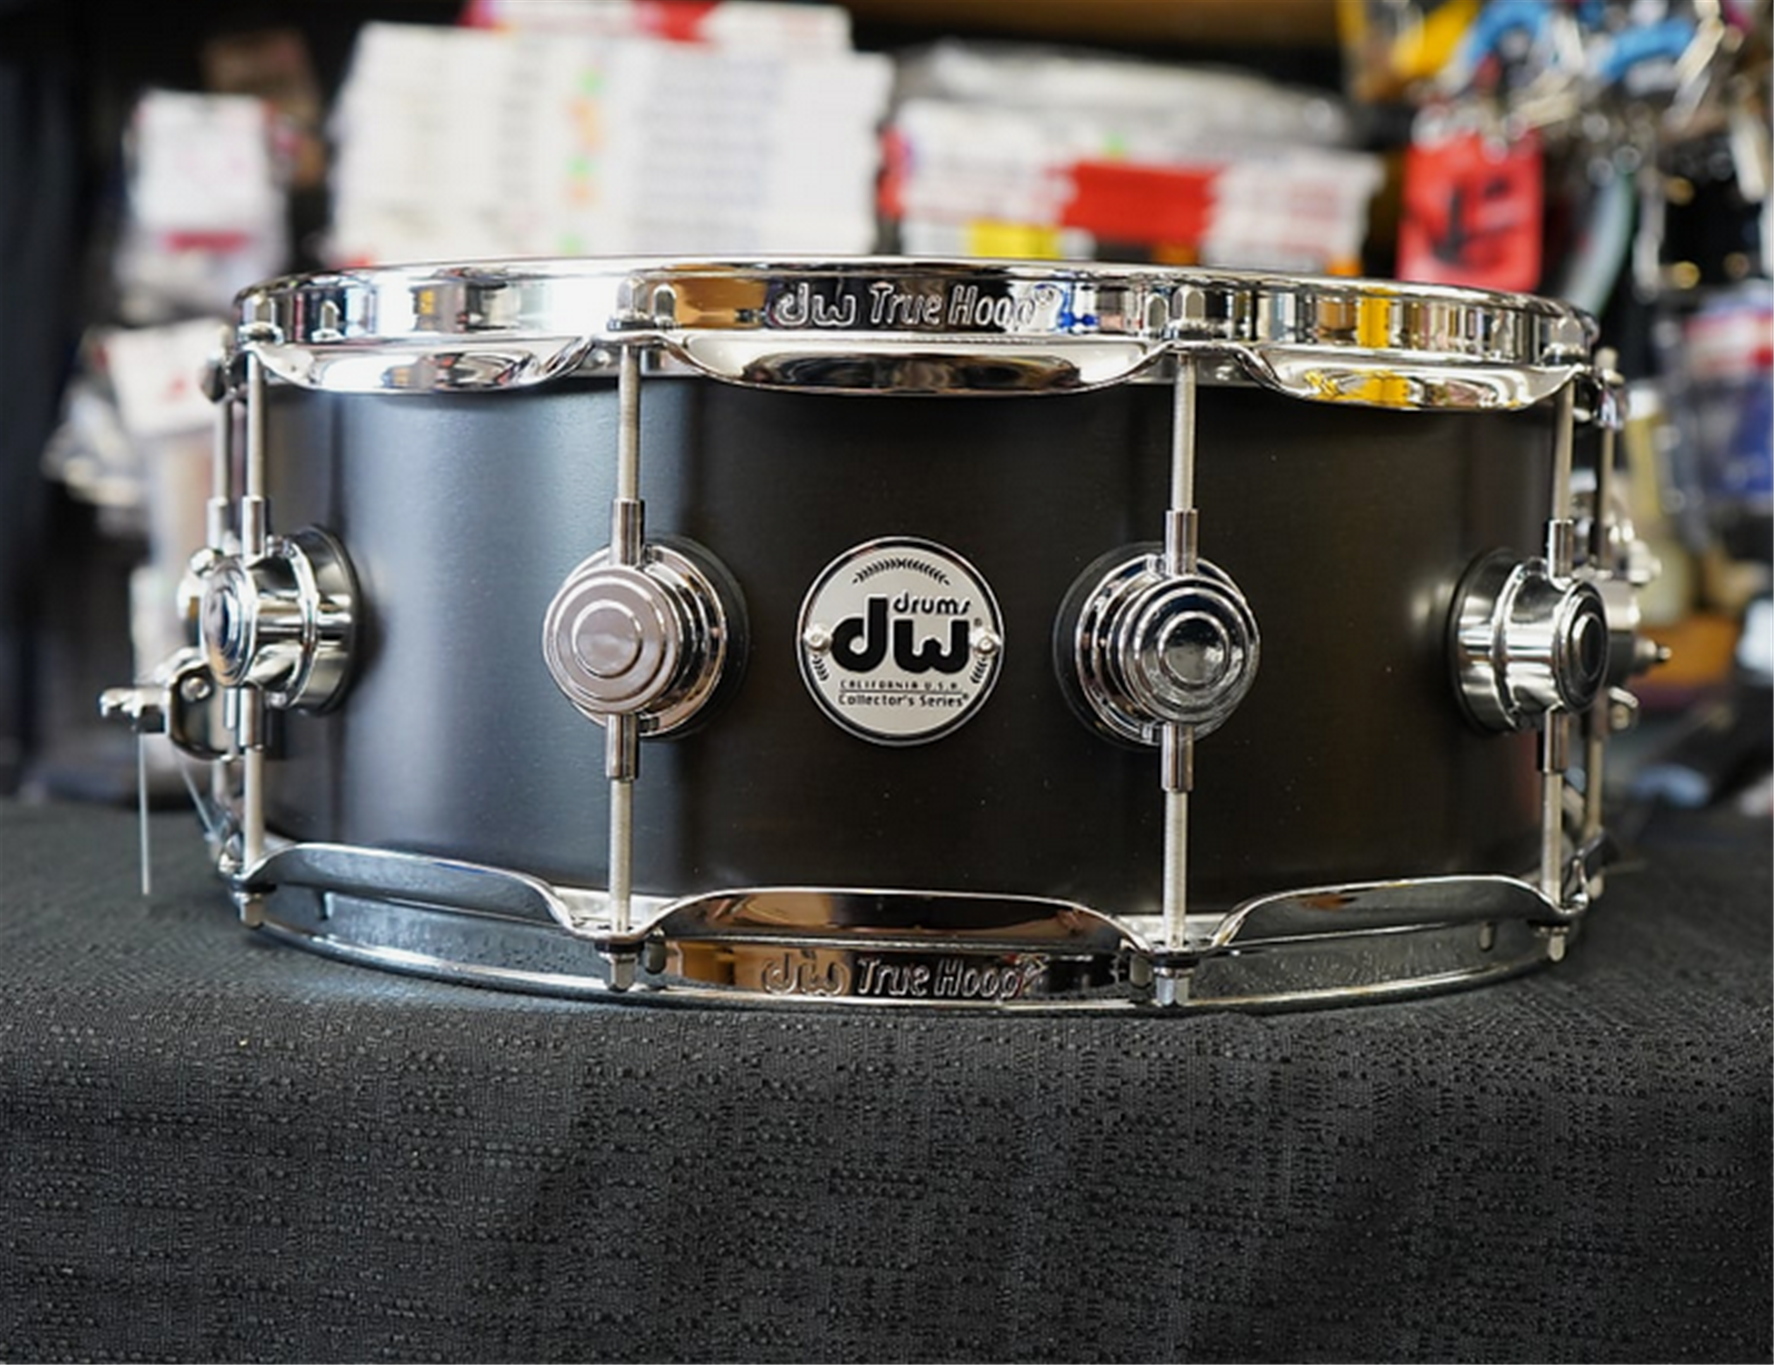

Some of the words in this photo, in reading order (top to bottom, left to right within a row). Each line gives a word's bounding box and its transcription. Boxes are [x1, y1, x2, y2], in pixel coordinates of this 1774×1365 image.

[774, 281, 857, 327] dw
[869, 281, 943, 326] True
[893, 591, 971, 615] drums
[830, 596, 971, 674] dw
[838, 694, 915, 707] Collector's
[840, 679, 918, 690] CALIFORNIA
[763, 951, 849, 997] dw
[856, 956, 930, 996] True
